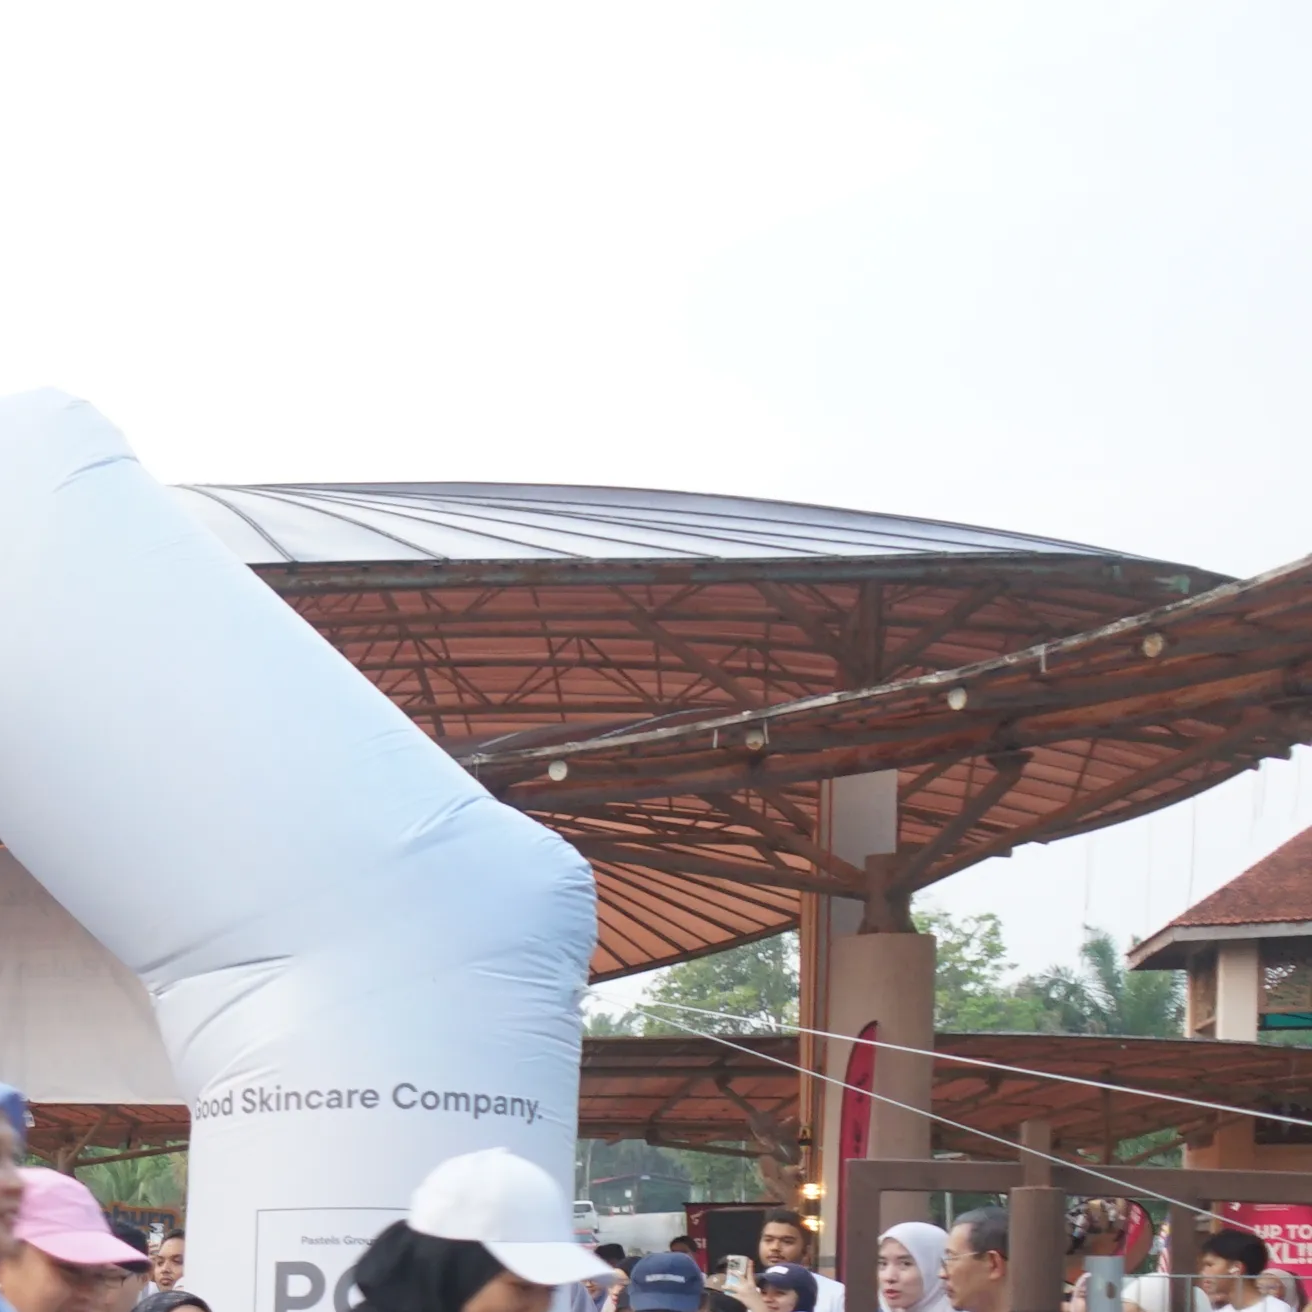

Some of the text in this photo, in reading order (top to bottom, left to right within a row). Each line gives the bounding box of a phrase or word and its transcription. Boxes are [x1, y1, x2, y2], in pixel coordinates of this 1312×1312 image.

[195, 1082, 544, 1125] Good Skincare Company.
[301, 1236, 375, 1246] Pastels Grou
